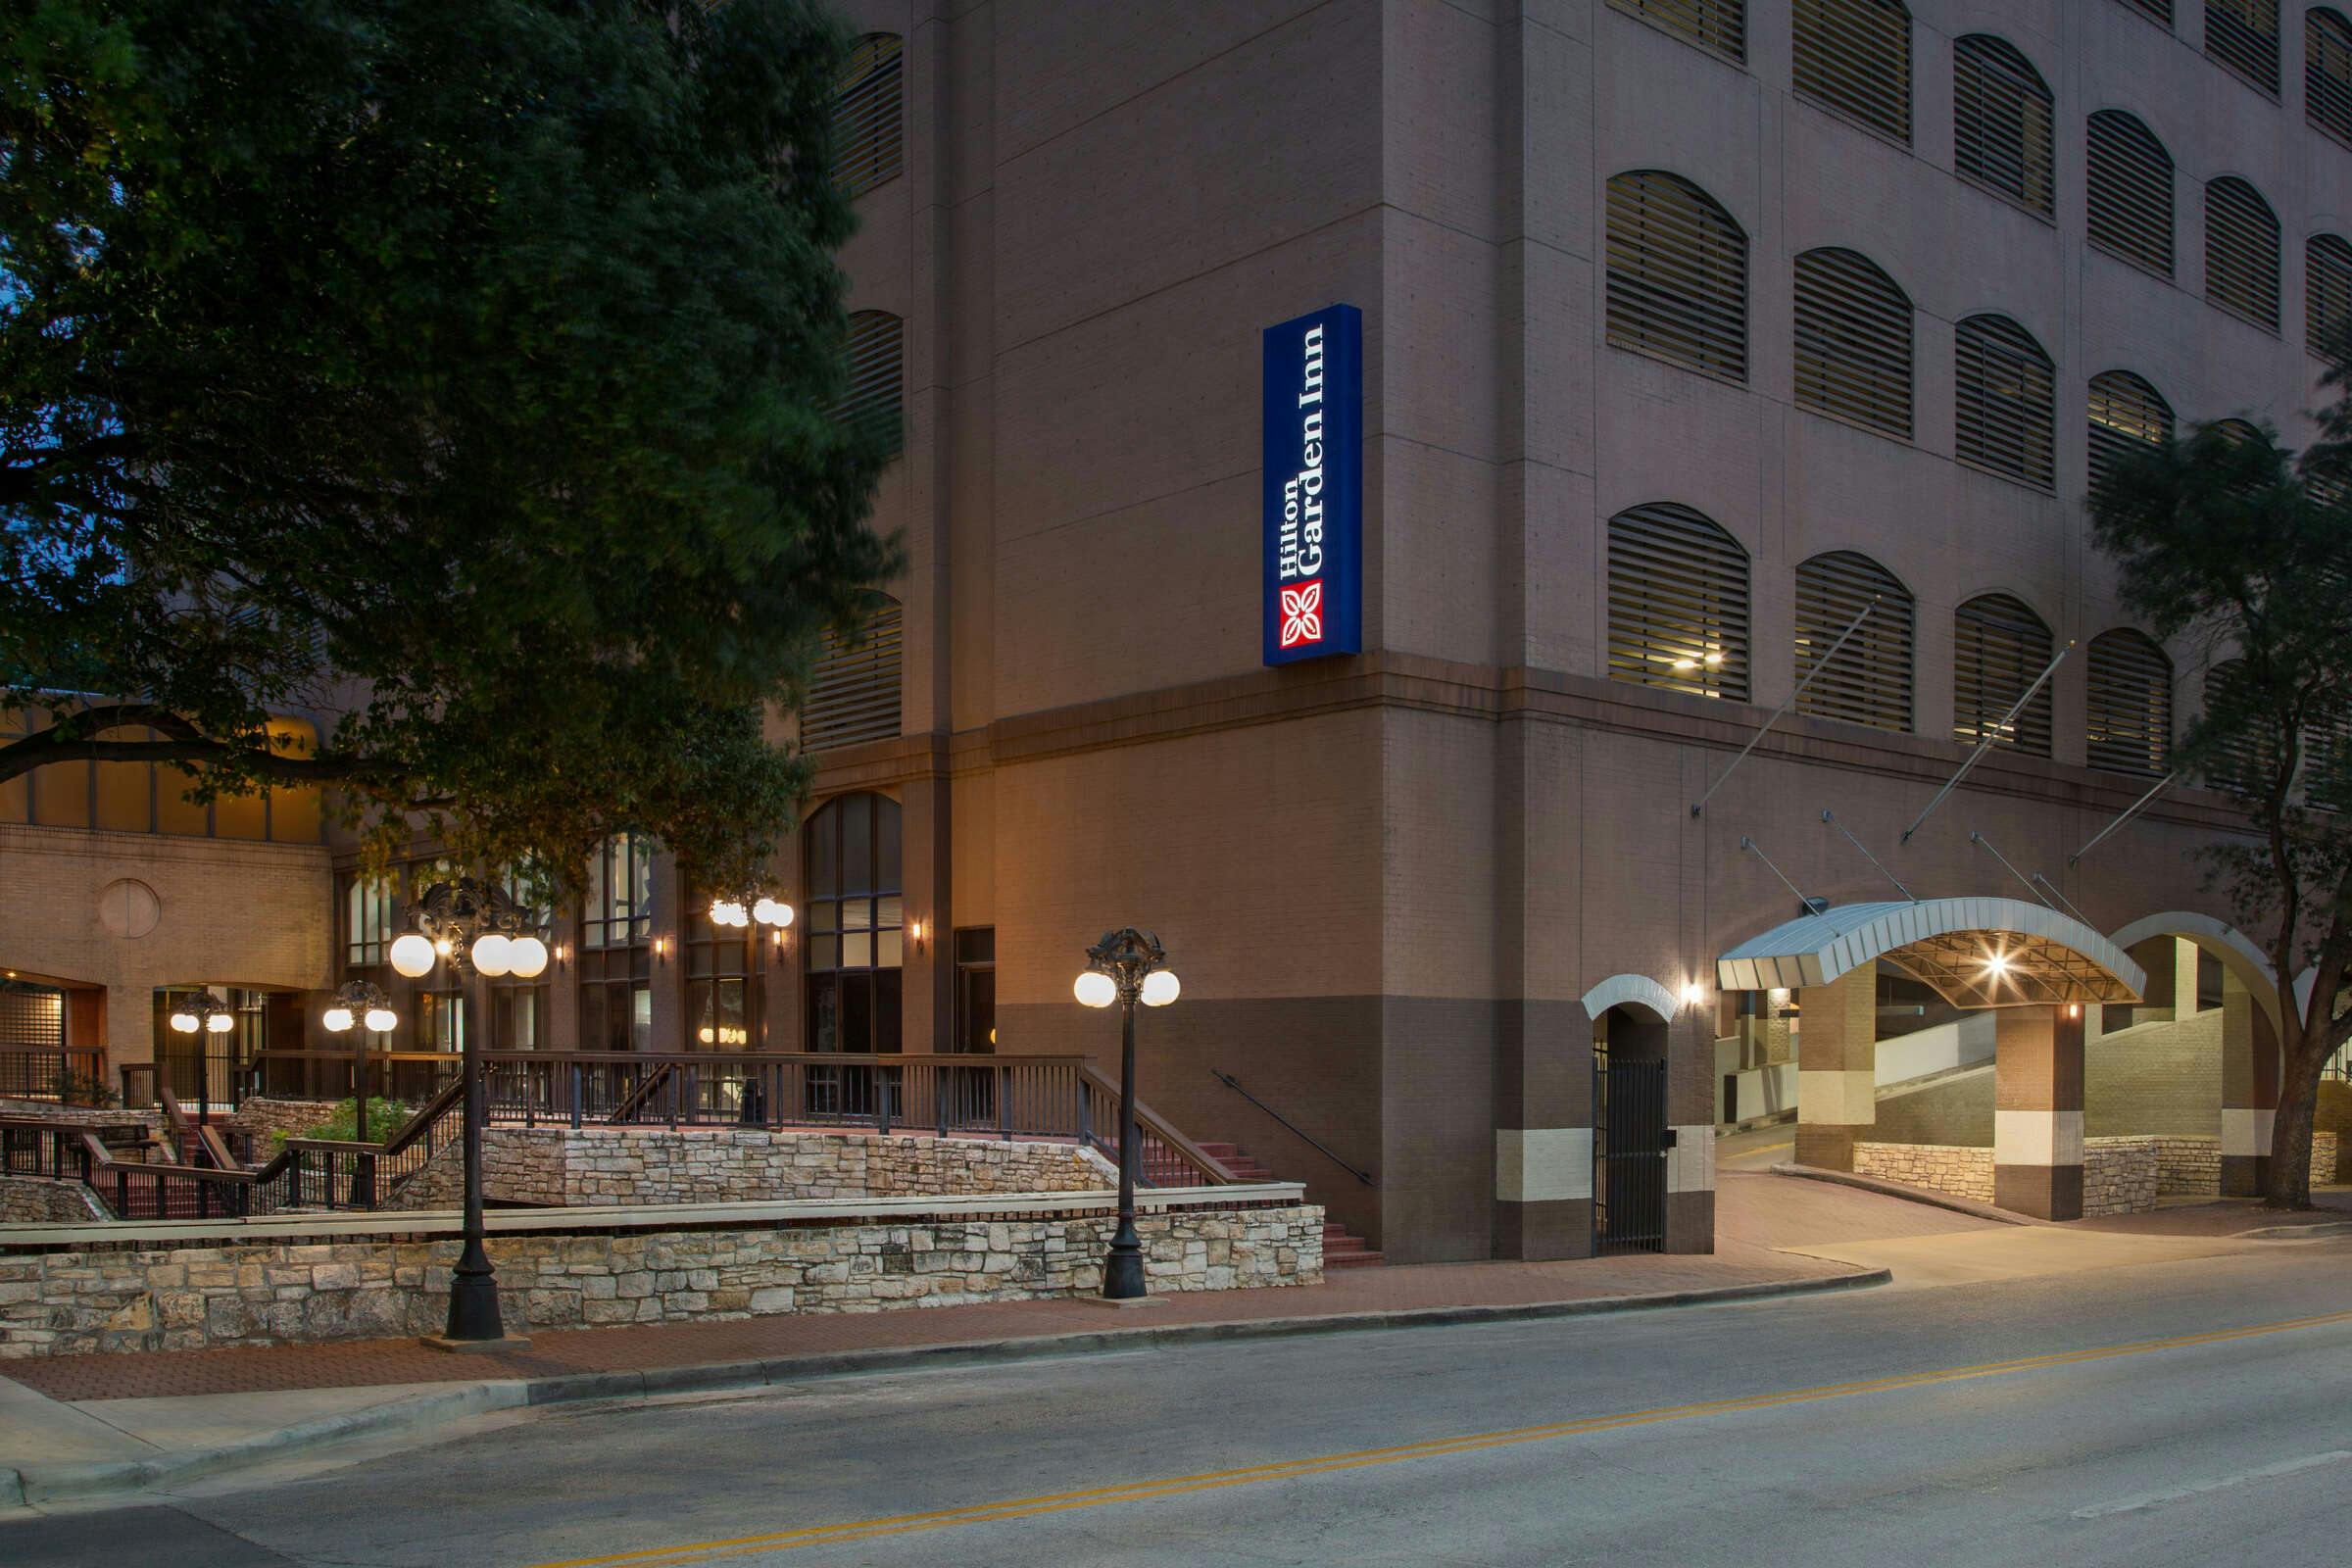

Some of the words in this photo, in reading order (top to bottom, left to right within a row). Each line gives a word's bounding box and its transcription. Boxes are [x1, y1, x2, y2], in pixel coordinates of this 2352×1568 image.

[1298, 323, 1323, 409] Inn
[1280, 477, 1298, 580] Hilton
[1298, 409, 1323, 576] Garden
